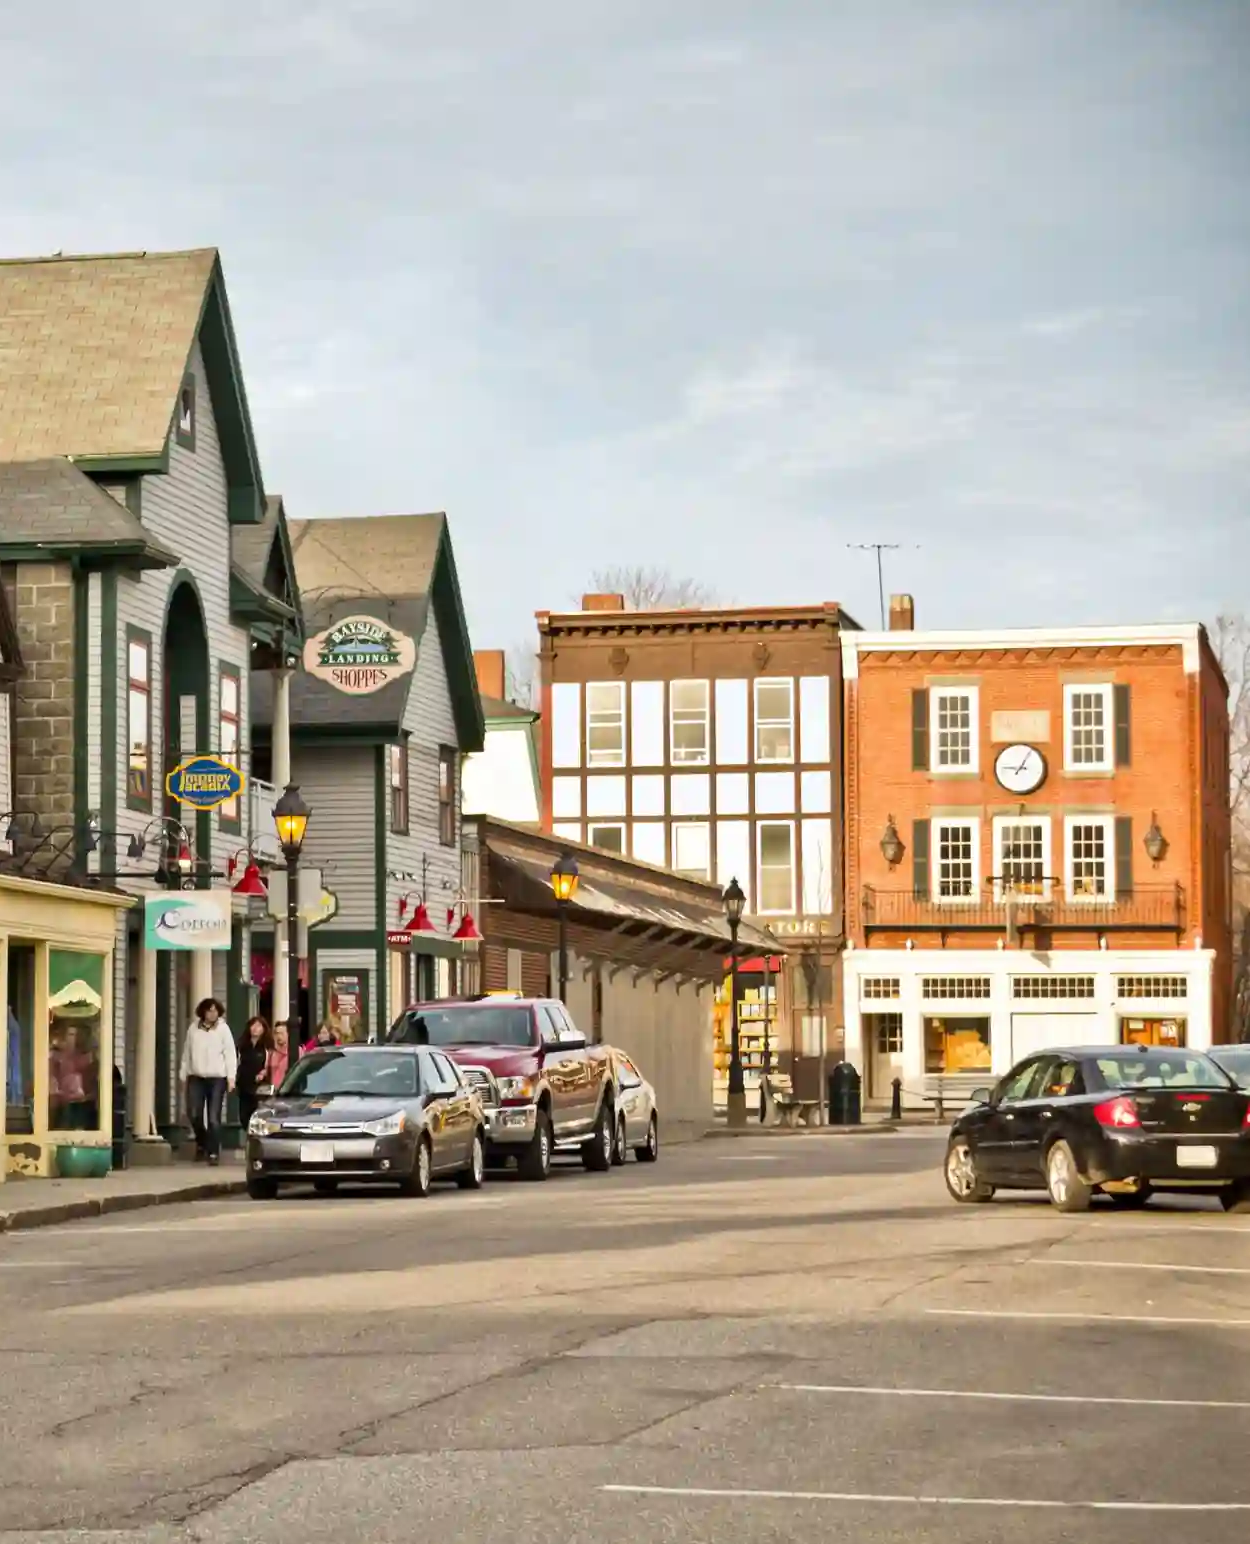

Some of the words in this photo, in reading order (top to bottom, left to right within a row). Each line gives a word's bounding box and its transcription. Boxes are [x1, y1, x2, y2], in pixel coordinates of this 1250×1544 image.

[332, 622, 387, 643] BAYSIDE
[328, 653, 389, 664] LANDING
[332, 668, 388, 689] SHOPPES
[391, 935, 408, 943] ATM
